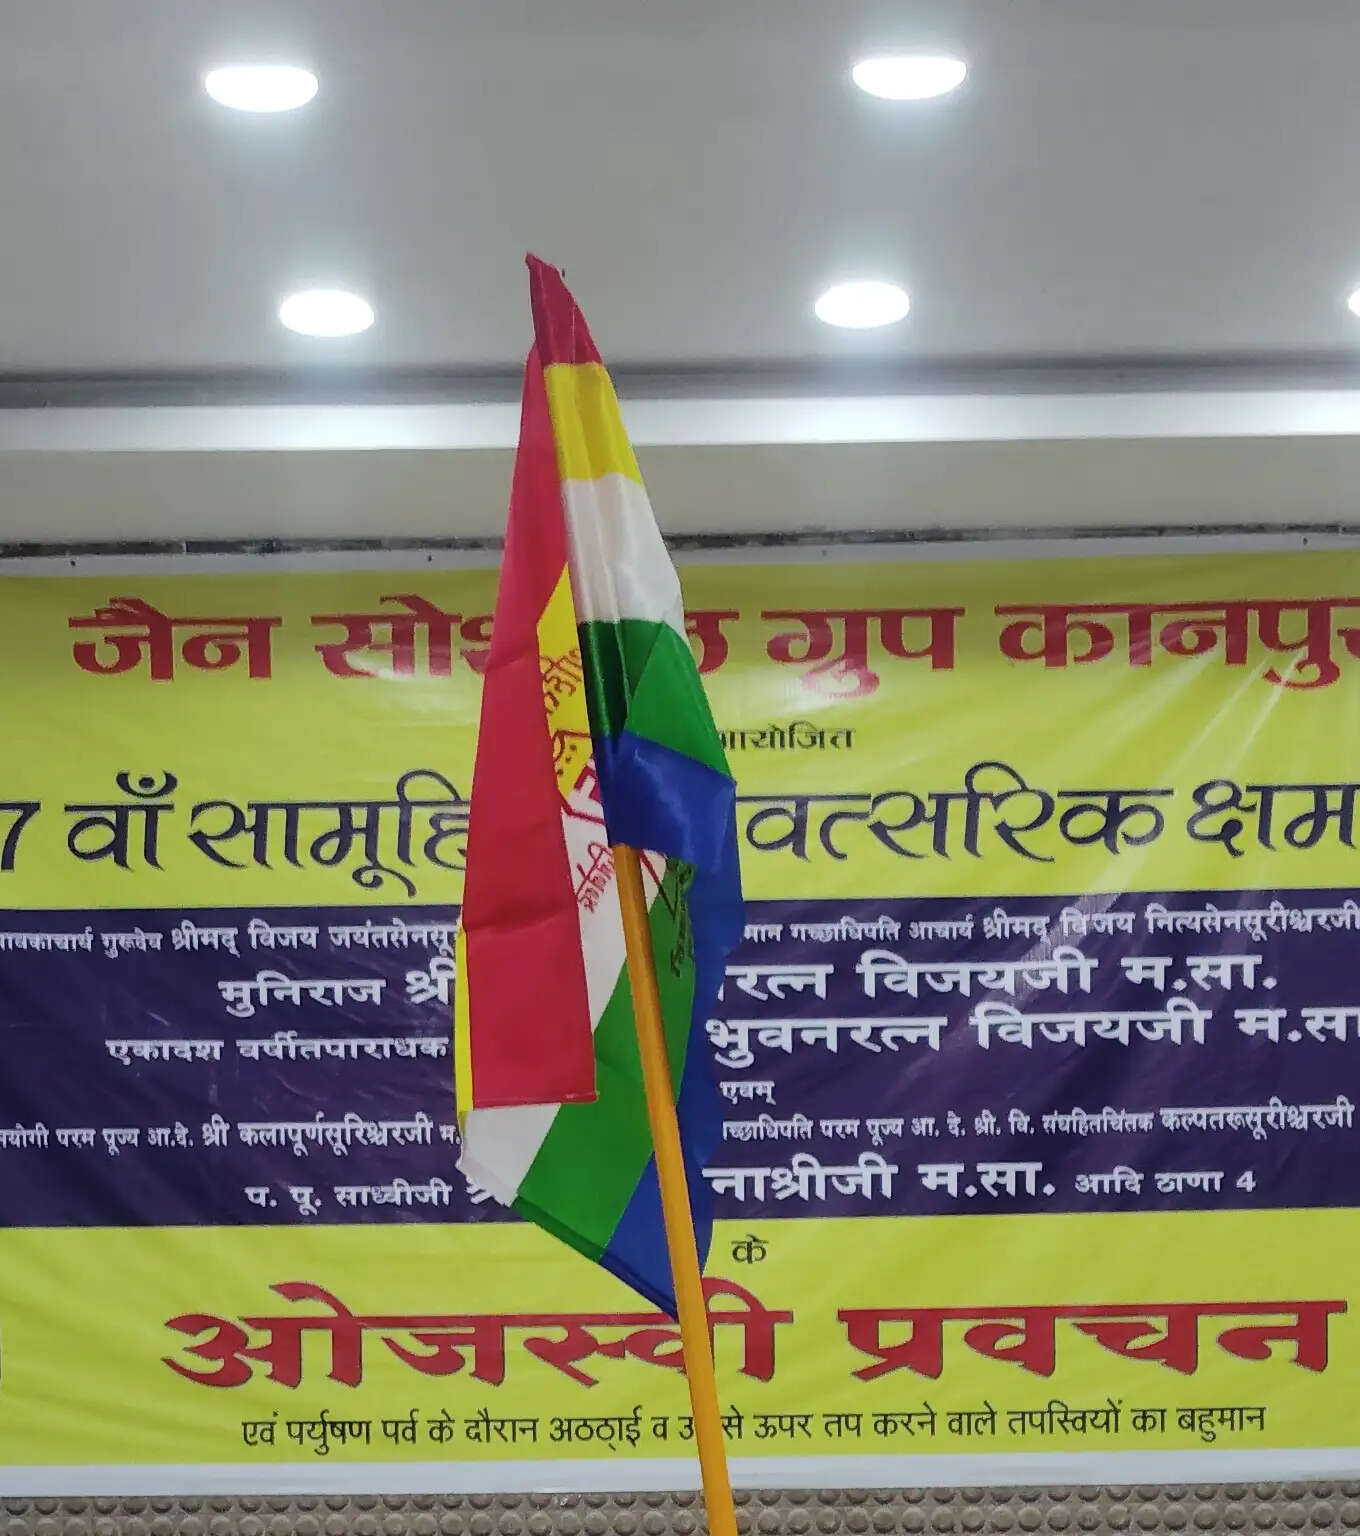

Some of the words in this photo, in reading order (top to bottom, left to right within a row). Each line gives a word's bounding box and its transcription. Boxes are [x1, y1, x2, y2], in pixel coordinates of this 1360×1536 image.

[69, 595, 283, 682] जैन
[761, 607, 965, 697] ग्रुप
[65, 769, 181, 871] वाँ
[188, 768, 470, 898] सामूहि
[736, 758, 1172, 862] वत्सरिक
[171, 919, 241, 958] श्रीमद्
[247, 918, 320, 950] विजय
[328, 917, 458, 957] जयंतसेनसू
[908, 913, 975, 941] आचार्य
[983, 907, 1053, 946] श्रीमद्
[1059, 906, 1136, 937] विजय
[217, 969, 387, 1018] मुनिराज
[719, 963, 835, 1001] रत्न
[855, 946, 1099, 999] विजयजी
[1120, 954, 1278, 993] म.सा.
[705, 1016, 948, 1070] भुवनरत्न
[968, 999, 1213, 1049] विजयजी
[719, 1079, 777, 1106] एवम्
[55, 1128, 96, 1150] परम
[102, 1127, 141, 1157] पूज्य
[201, 1113, 230, 1148] श्री
[819, 1118, 861, 1140] परम
[865, 1117, 905, 1147] पूज्य
[244, 1185, 278, 1208] प.
[288, 1185, 323, 1217] पू.
[333, 1177, 454, 1208] साध्वीजी
[701, 1152, 900, 1202] नाश्रीजी
[917, 1160, 1056, 1199] म.सा.
[1074, 1165, 1145, 1195] आदि
[1153, 1170, 1225, 1194] ठाणा
[1235, 1170, 1257, 1193] 4
[729, 1233, 769, 1266] के
[161, 1280, 795, 1390] ओजस्वी
[840, 1298, 1349, 1382] प्रवचन
[241, 1410, 280, 1447] एवं
[285, 1409, 372, 1457] पर्युषण
[381, 1407, 420, 1446] पर्व
[427, 1408, 456, 1444] के
[463, 1407, 539, 1445] दौरान
[650, 1415, 670, 1440] व
[677, 1403, 745, 1441] उसे
[752, 1413, 814, 1439] ऊपर
[822, 1413, 864, 1438] तप
[871, 1400, 938, 1438] करने
[946, 1400, 999, 1436] वाले
[1006, 1397, 1124, 1435] तपस्वियों
[1130, 1407, 1168, 1435] का
[1175, 1405, 1268, 1443] बहुमान
